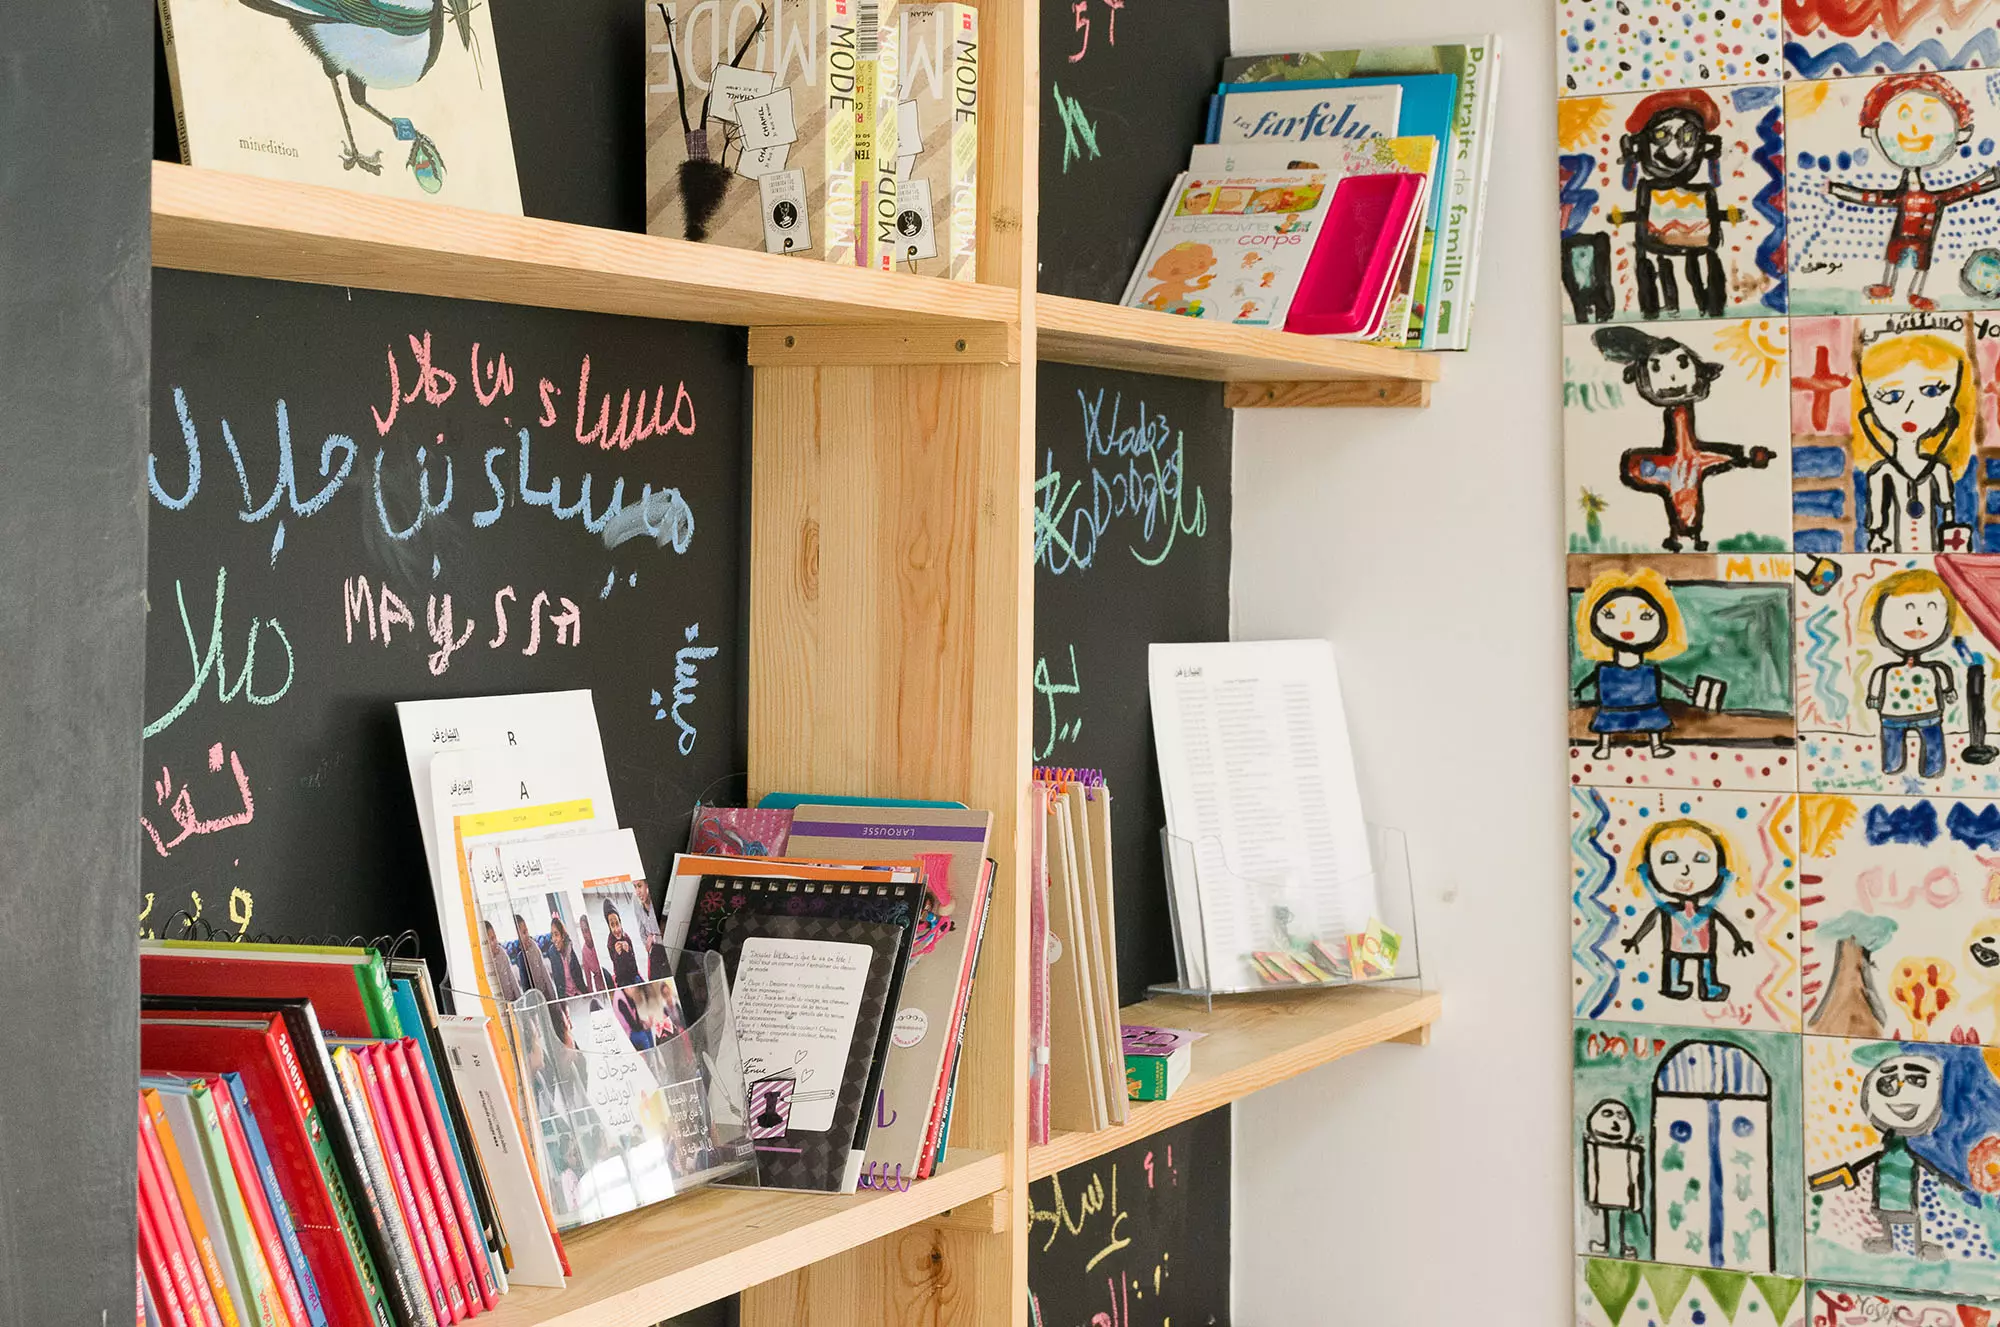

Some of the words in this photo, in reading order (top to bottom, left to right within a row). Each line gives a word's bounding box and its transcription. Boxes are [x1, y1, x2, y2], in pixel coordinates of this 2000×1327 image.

[829, 24, 856, 113] MODE
[955, 39, 977, 125] MODE
[1457, 47, 1484, 160] Portraits
[239, 136, 299, 158] minedition
[1454, 168, 1473, 196] de
[878, 160, 897, 244] MODE
[1238, 234, 1302, 250] corps
[1442, 203, 1468, 294] famille
[507, 731, 518, 746] R
[520, 781, 530, 800] A
[863, 826, 915, 837] LAROUSSE
[275, 1032, 305, 1088] KIDIDOC
[264, 1163, 283, 1201] coucher
[169, 1250, 187, 1280] bobo
